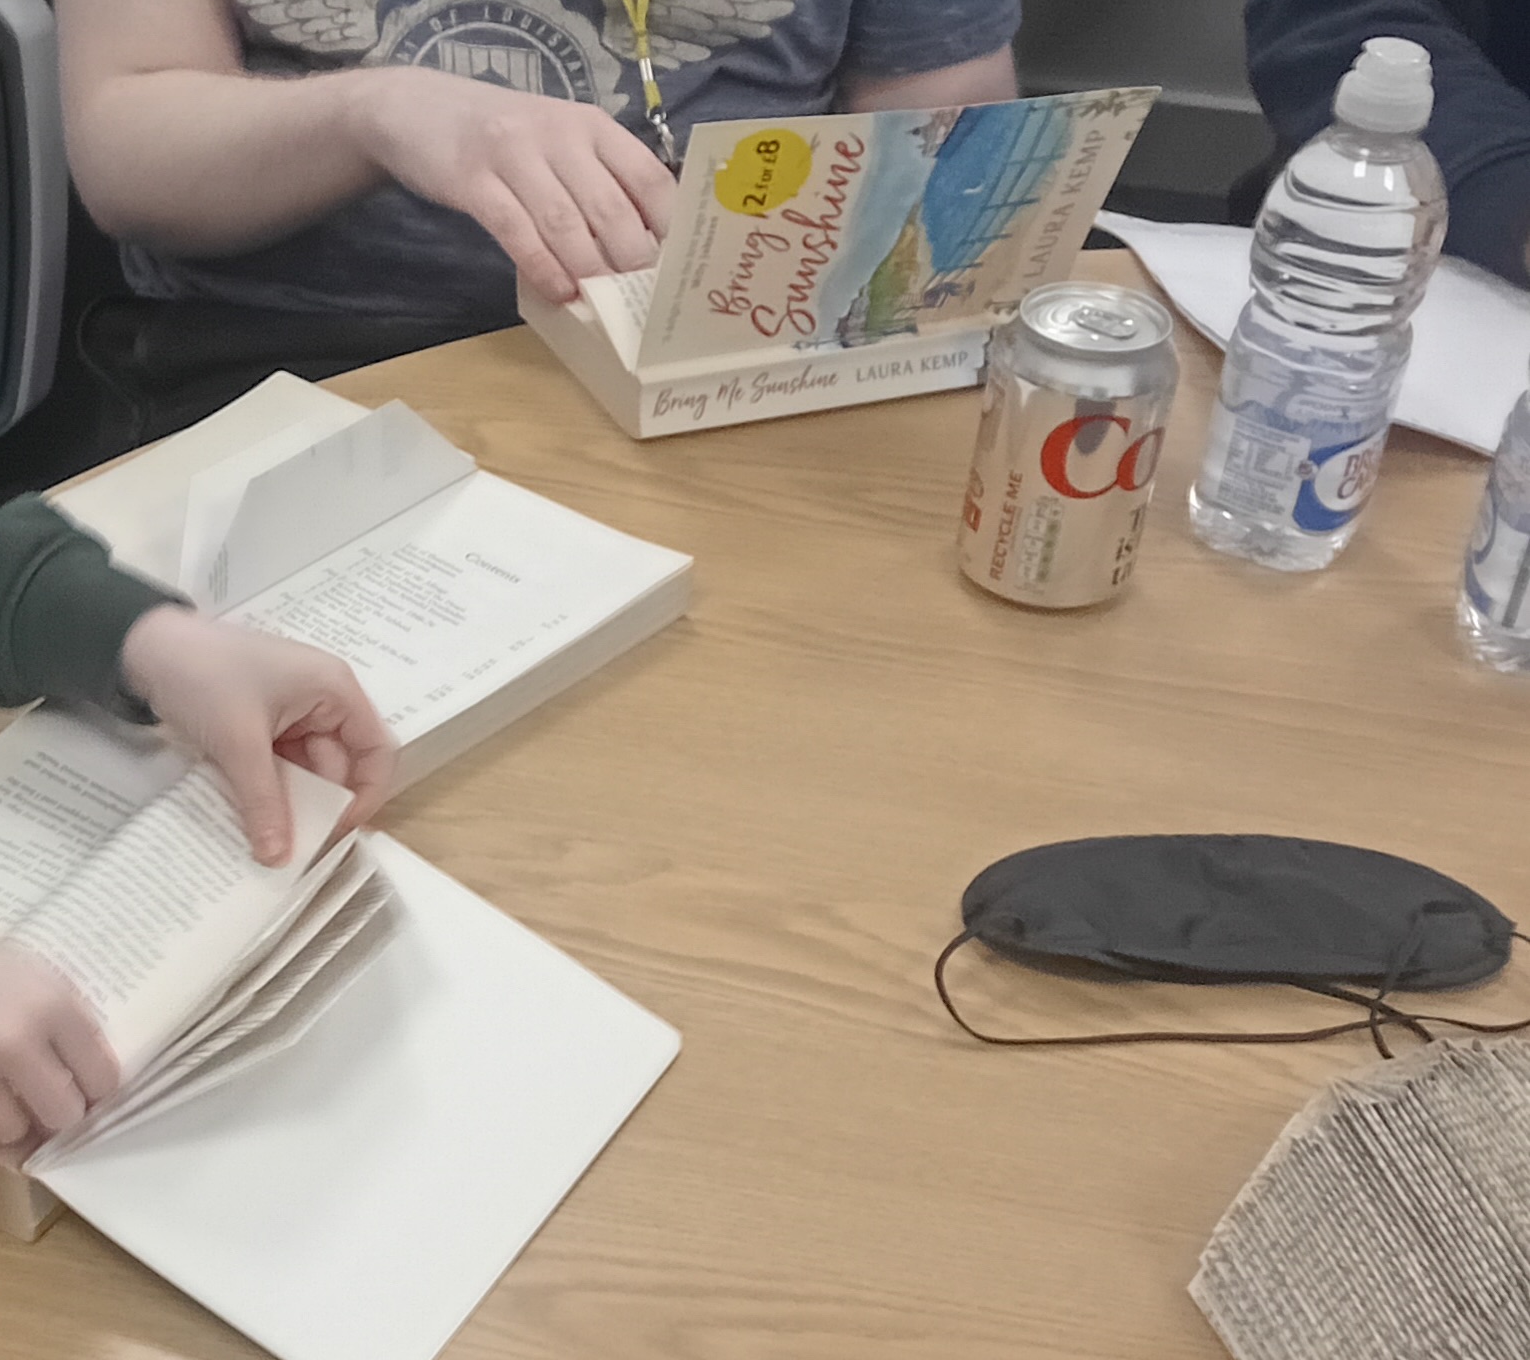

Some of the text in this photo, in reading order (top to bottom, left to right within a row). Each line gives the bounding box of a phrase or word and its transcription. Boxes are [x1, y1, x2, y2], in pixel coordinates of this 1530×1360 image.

[743, 191, 767, 208] 2
[755, 168, 774, 191] for
[1023, 129, 1106, 279] LAURA KEMP
[707, 226, 791, 317] Bring
[751, 132, 865, 337] Sunshine
[653, 350, 970, 420] Bring Me Sunshine LAURA KEMP
[464, 551, 521, 584] Contents
[989, 469, 1023, 581] RECYCLE ME
